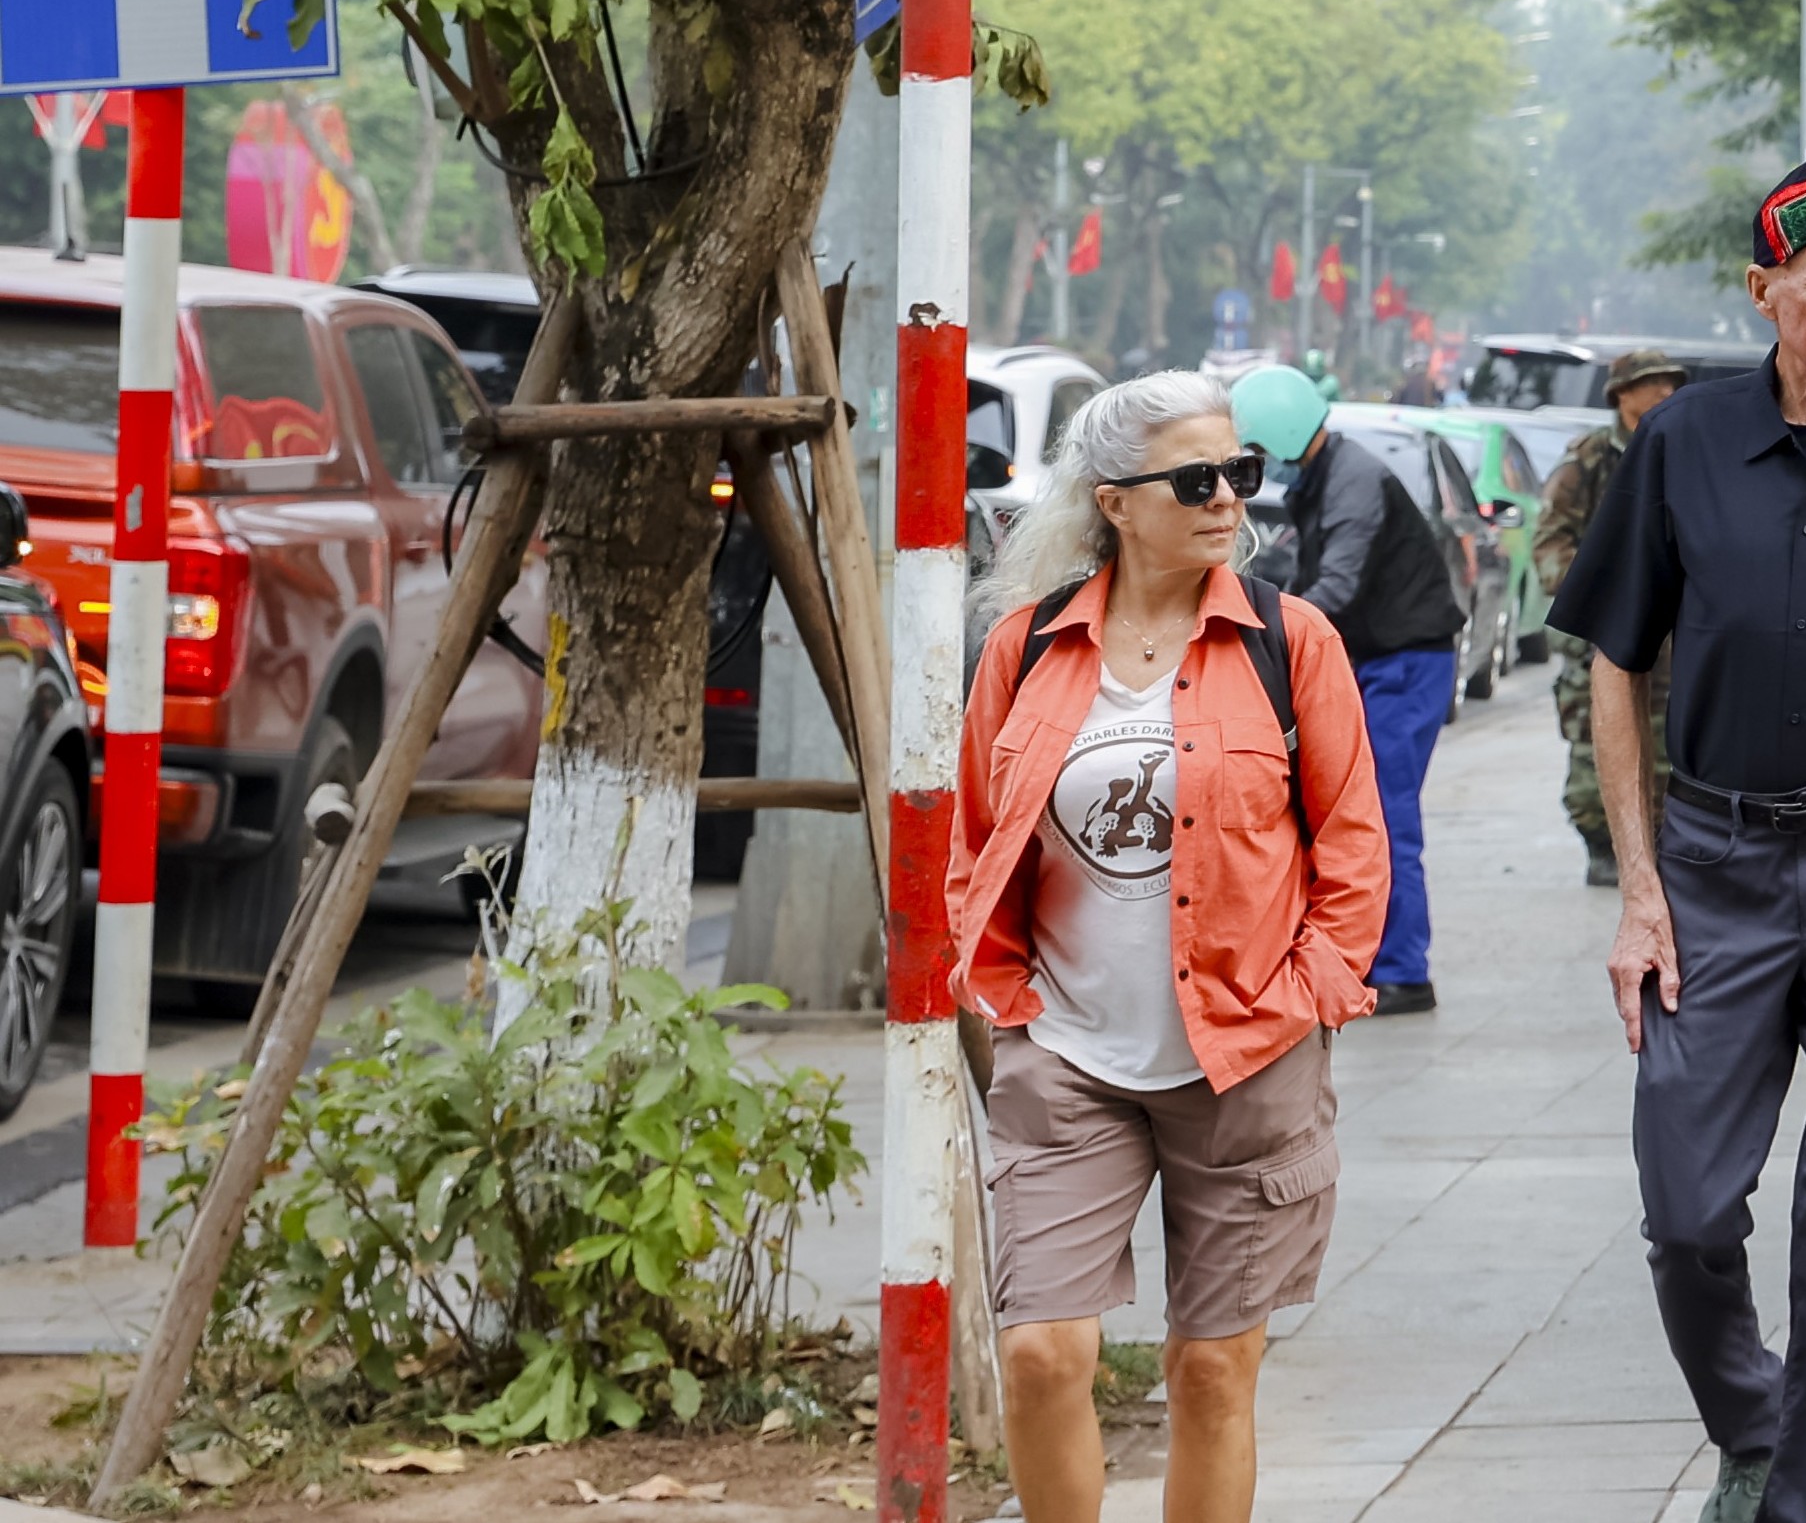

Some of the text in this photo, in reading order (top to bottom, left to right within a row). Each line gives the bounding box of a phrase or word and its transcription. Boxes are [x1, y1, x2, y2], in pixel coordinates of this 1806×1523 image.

[1073, 725, 1174, 747] CHARLES DAR
[1143, 872, 1171, 894] ECU
